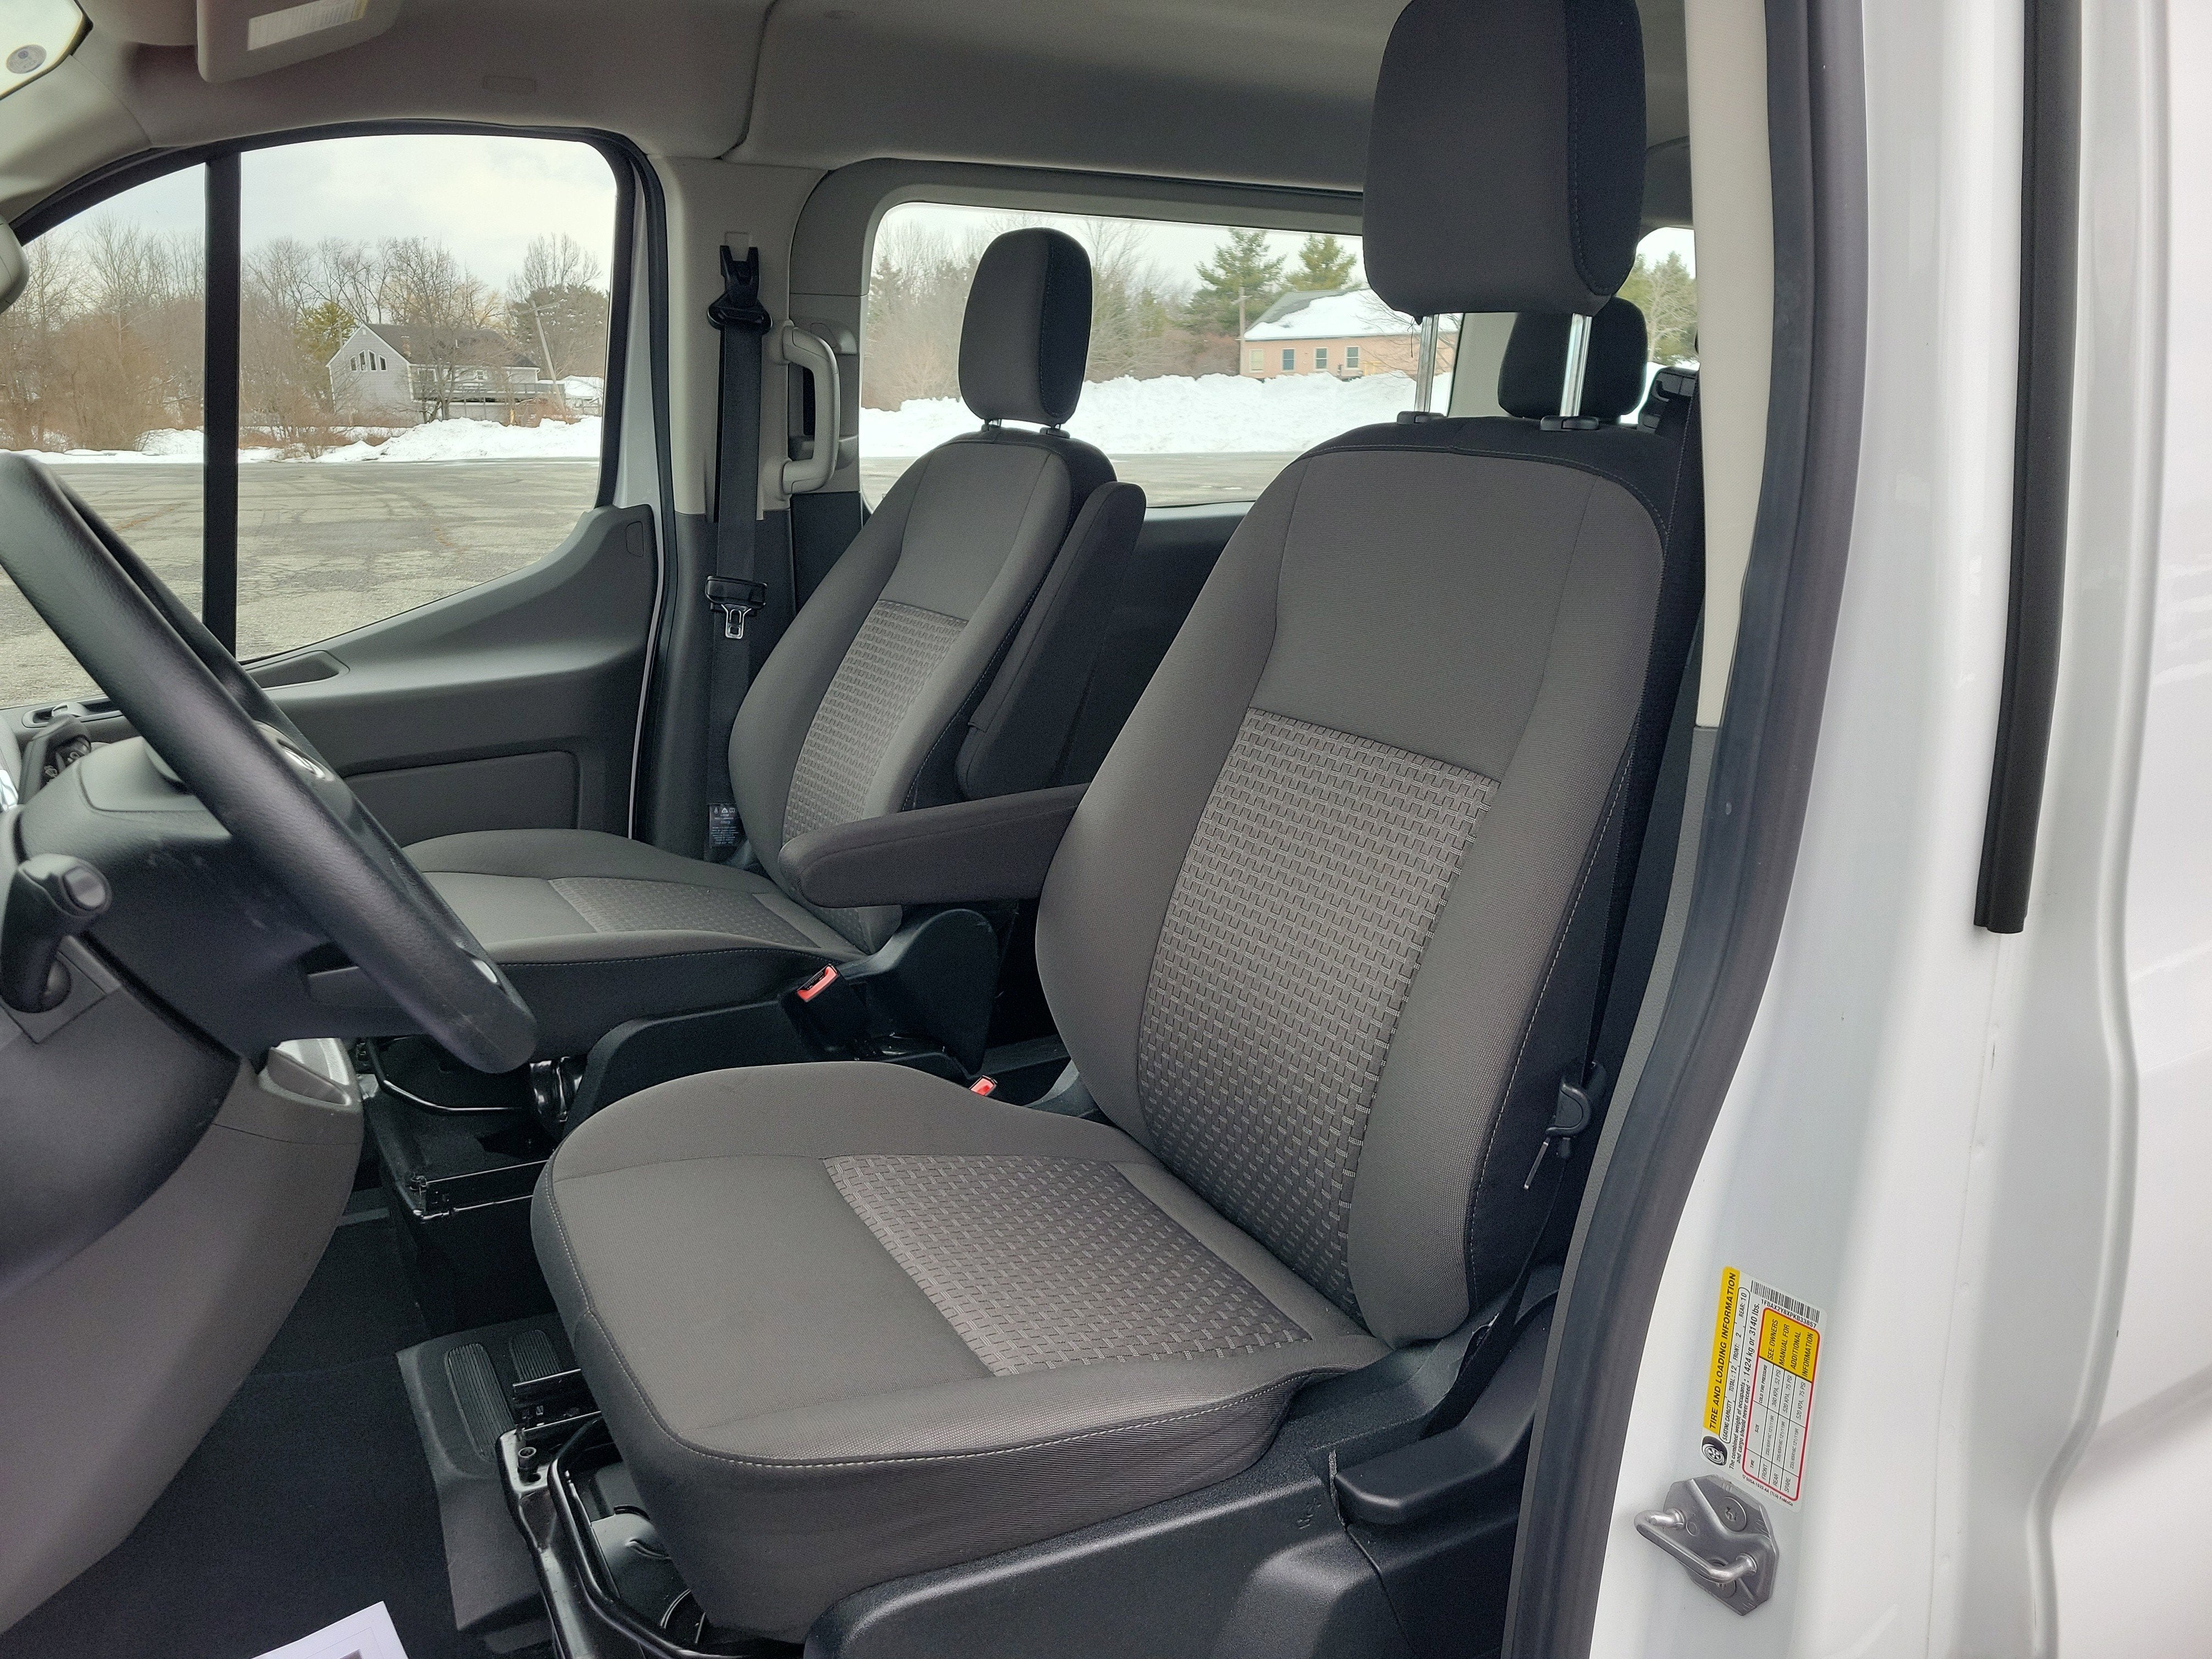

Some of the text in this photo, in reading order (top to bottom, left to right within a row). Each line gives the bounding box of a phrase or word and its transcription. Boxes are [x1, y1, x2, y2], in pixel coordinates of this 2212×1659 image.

[1752, 1304, 1760, 1316] lbs.
[1731, 1365, 1737, 1374] 12
[1741, 1292, 1747, 1301] 10
[1749, 1316, 1758, 1336] 3140
[1769, 1318, 1779, 1347] OWNERS
[1709, 1272, 1736, 1429] TIRE AND LOADING INFORMATION
[1746, 1346, 1755, 1357] kg
[1750, 1336, 1755, 1346] or
[1779, 1339, 1788, 1367] MANUAL
[1791, 1331, 1801, 1370] ADDITIONAL
[1802, 1331, 1814, 1378] INFORMATION
[1743, 1357, 1752, 1376] 1424
[1739, 1381, 1747, 1409] occupants
[1775, 1377, 1780, 1385] 52
